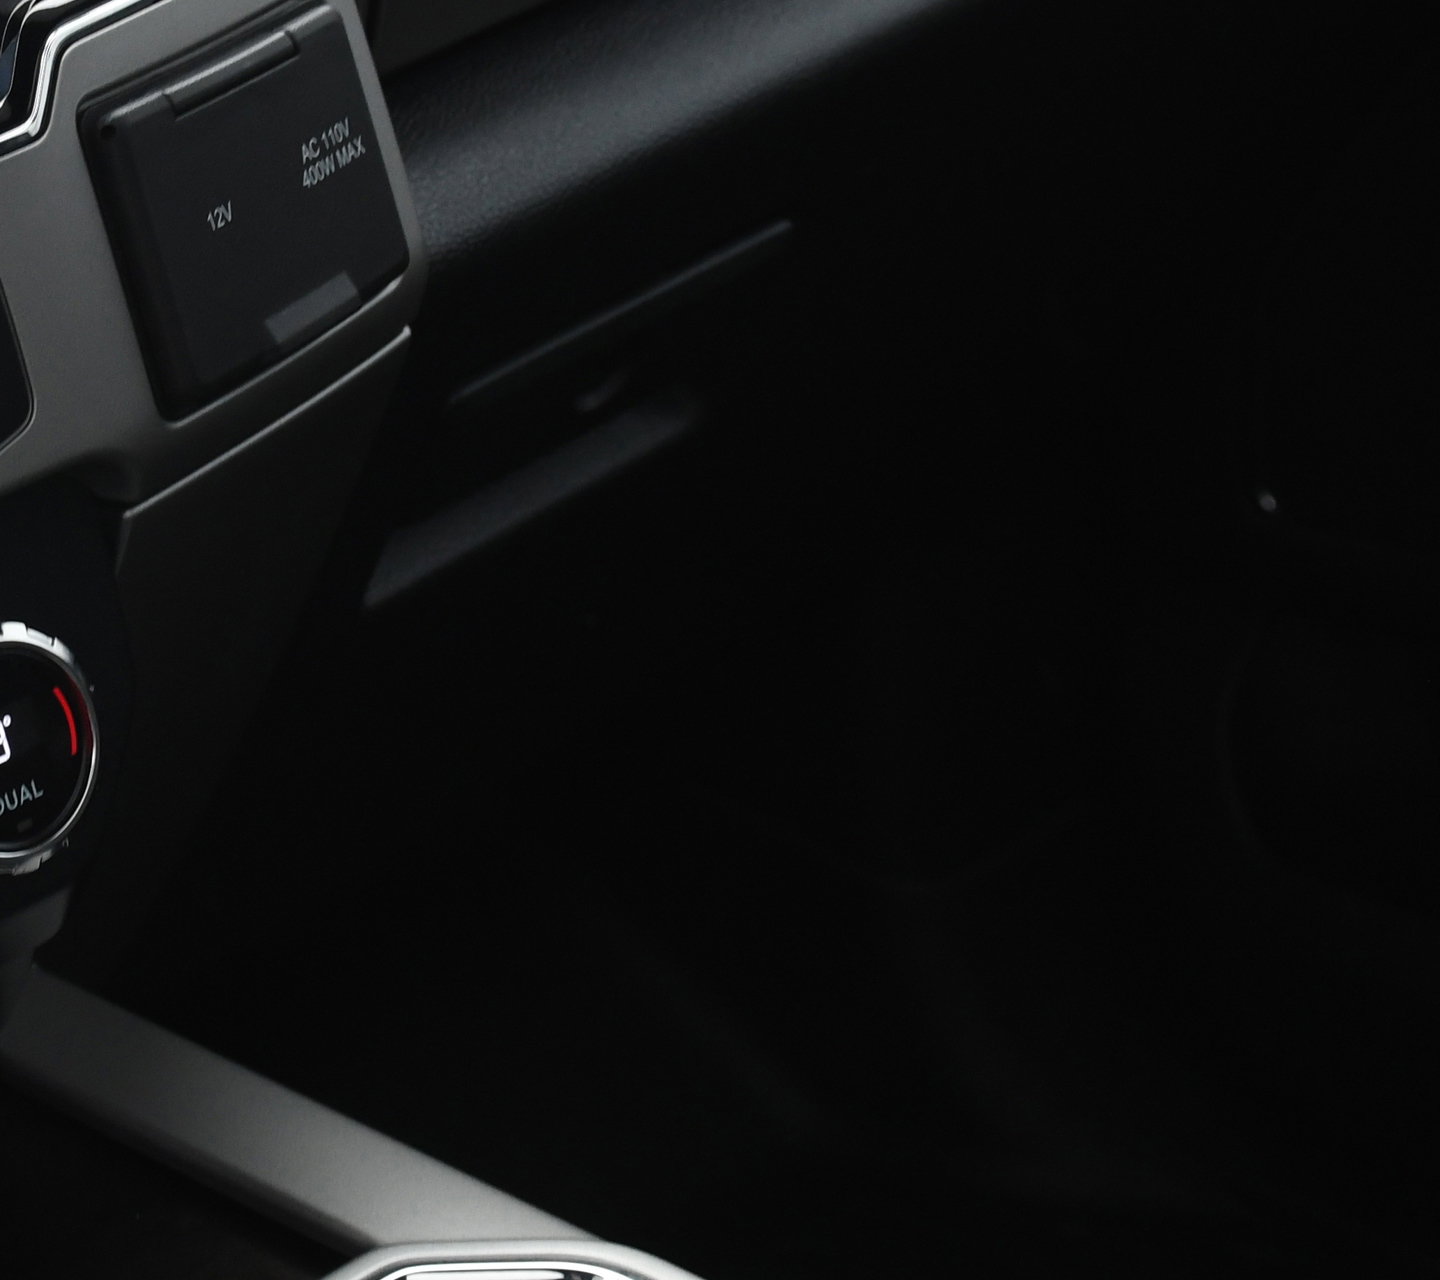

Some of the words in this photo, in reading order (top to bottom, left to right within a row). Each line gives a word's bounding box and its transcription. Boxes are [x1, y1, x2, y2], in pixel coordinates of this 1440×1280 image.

[302, 136, 321, 161] AC
[322, 116, 350, 151] 110V
[303, 153, 337, 188] 400W
[335, 135, 367, 169] MAX
[207, 200, 233, 231] 12V
